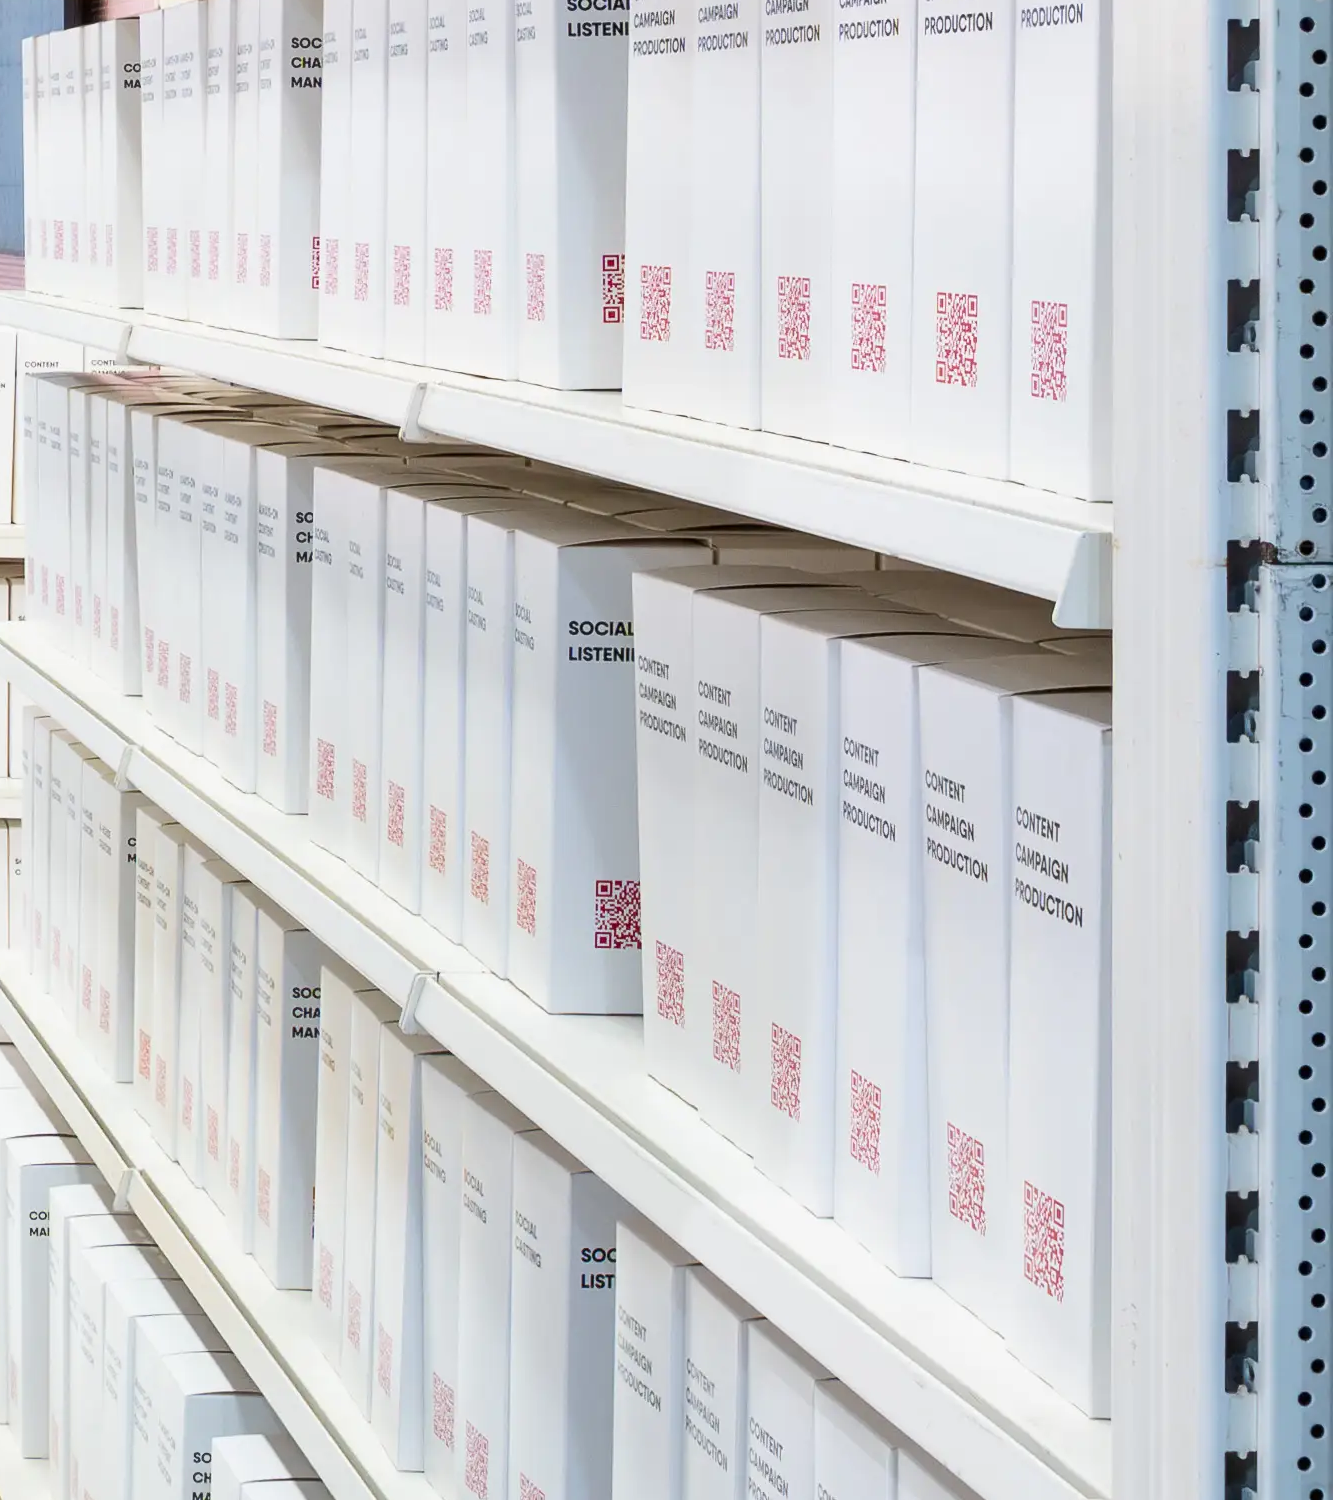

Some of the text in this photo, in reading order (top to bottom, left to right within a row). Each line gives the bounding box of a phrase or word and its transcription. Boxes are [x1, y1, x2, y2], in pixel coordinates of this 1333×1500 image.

[838, 18, 899, 40] PRODUCTION
[924, 11, 993, 35] PRODUCTION
[1021, 3, 1083, 27] PRODUCTION
[568, 620, 633, 636] SOCIAL
[925, 769, 965, 803] CONTENT
[926, 803, 974, 842] CAMPAIGN
[1016, 806, 1060, 842] CONTENT
[926, 836, 988, 882] PRODUCTION
[1015, 842, 1068, 883] CAMPAIGN
[1015, 877, 1083, 928] PRODUCTION
